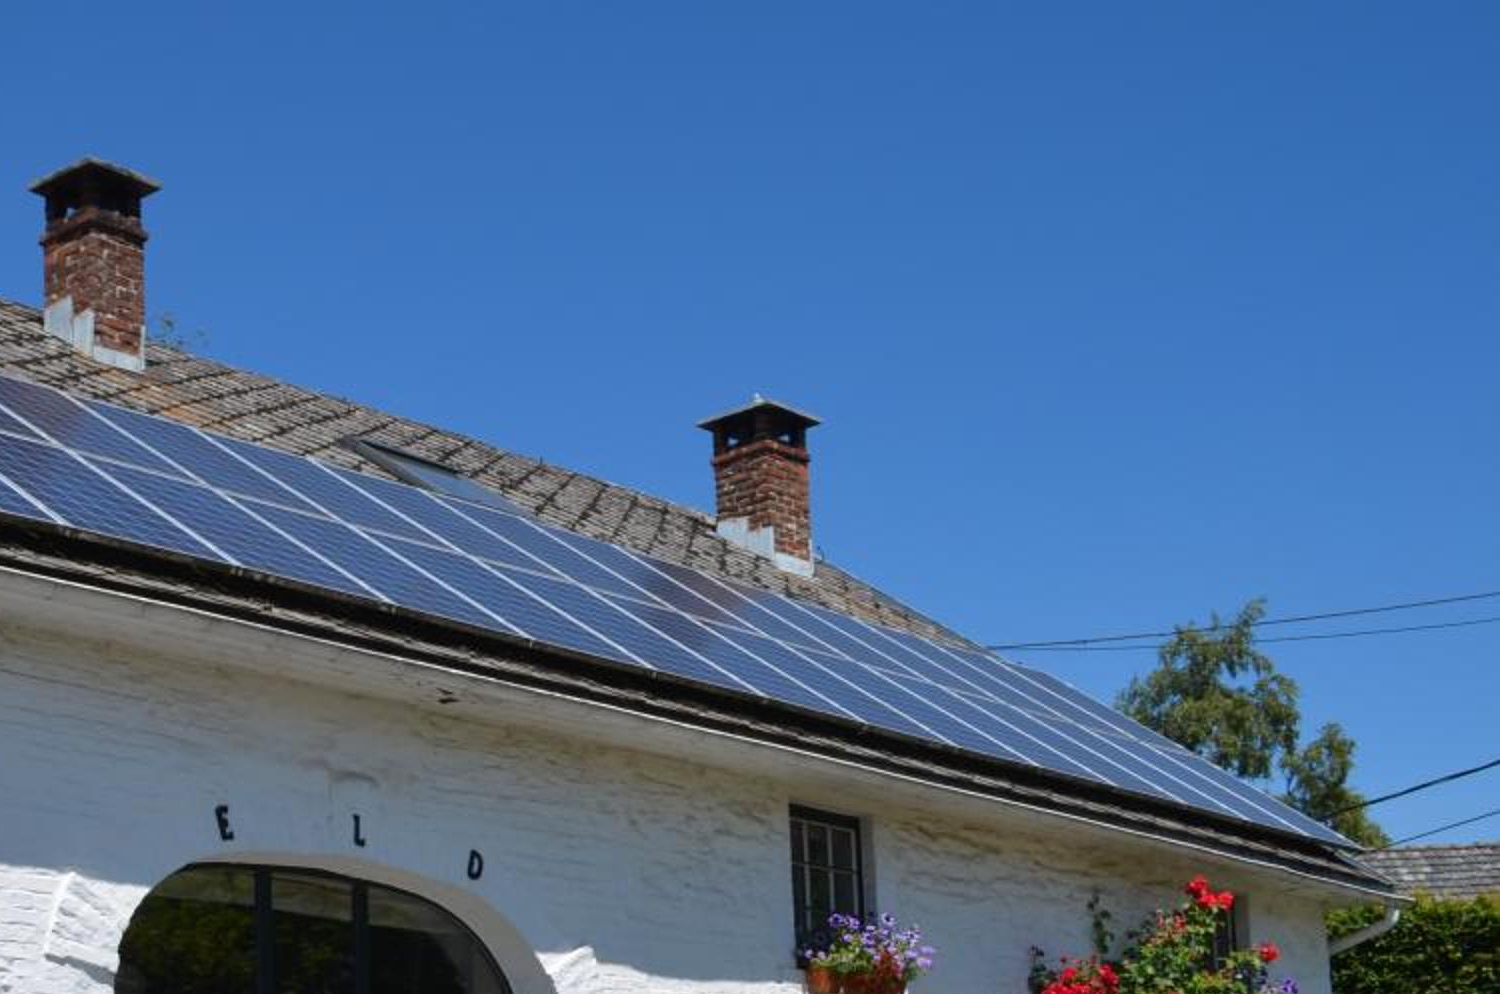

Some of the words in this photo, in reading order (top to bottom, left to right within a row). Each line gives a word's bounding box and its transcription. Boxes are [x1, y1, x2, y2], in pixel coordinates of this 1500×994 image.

[215, 804, 234, 841] E
[352, 813, 366, 848] L
[467, 849, 484, 880] D
